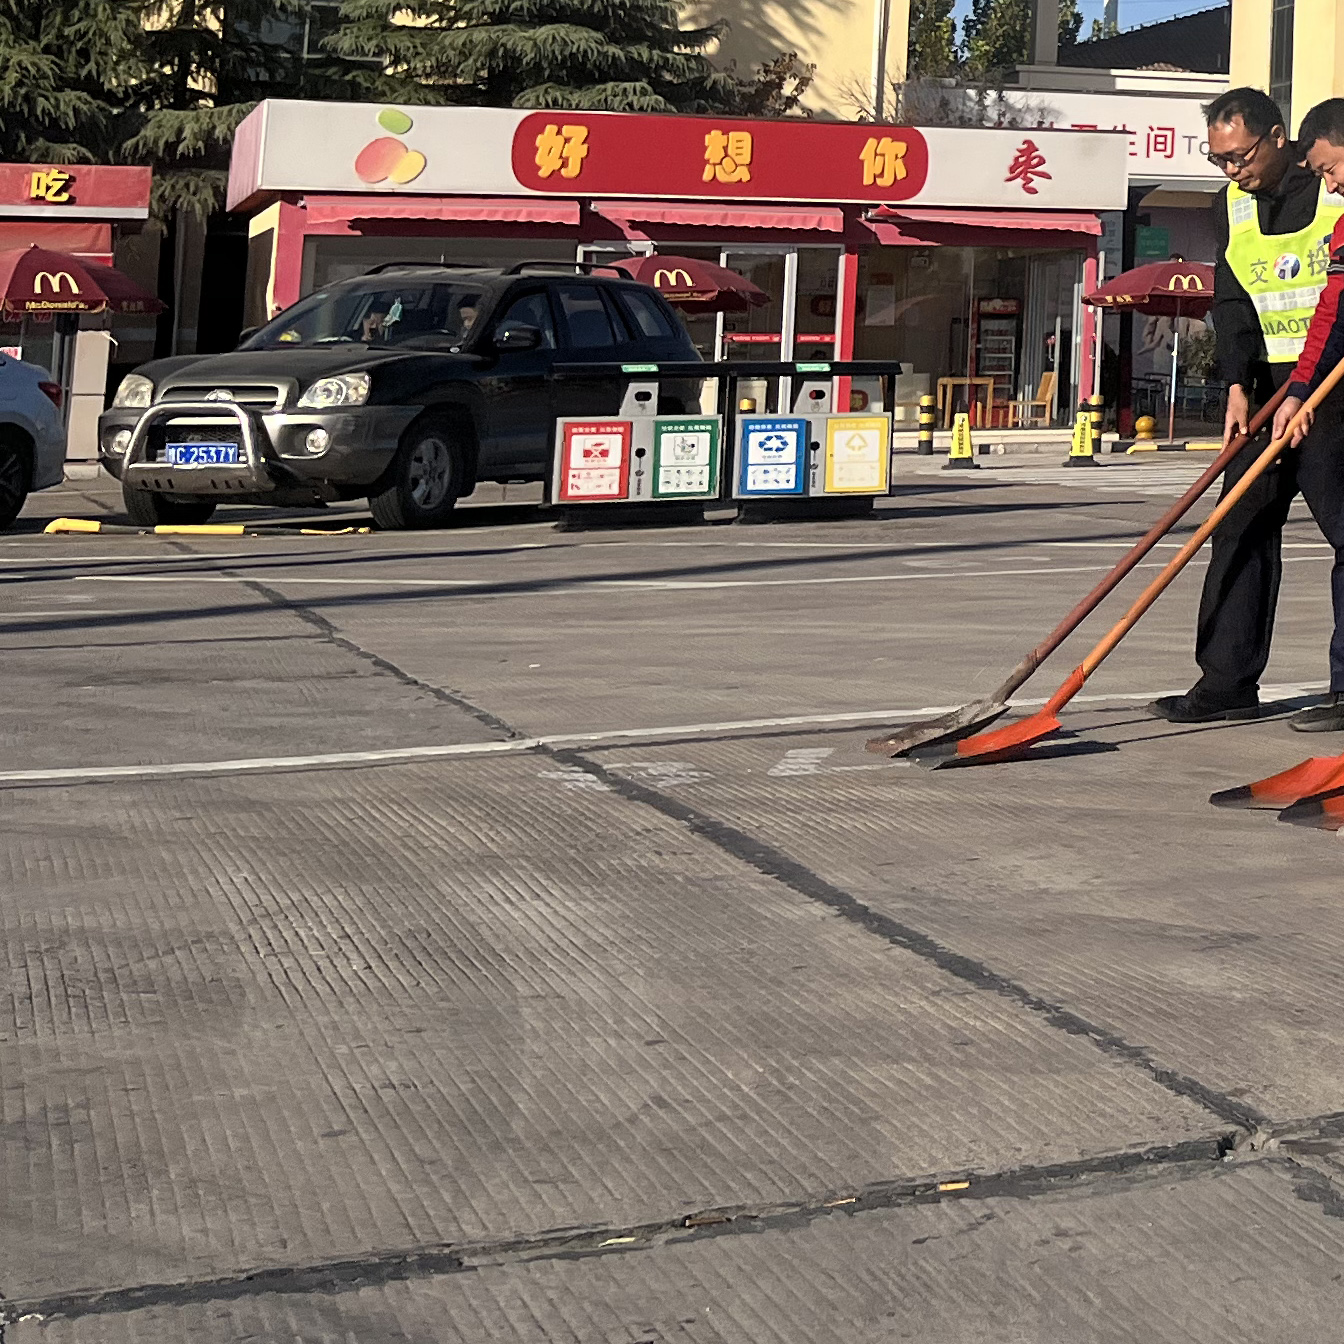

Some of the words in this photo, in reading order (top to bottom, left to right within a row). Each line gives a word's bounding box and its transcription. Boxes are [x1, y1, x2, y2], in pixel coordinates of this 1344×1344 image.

[536, 124, 907, 187] 好想你
[30, 168, 69, 202] 吃
